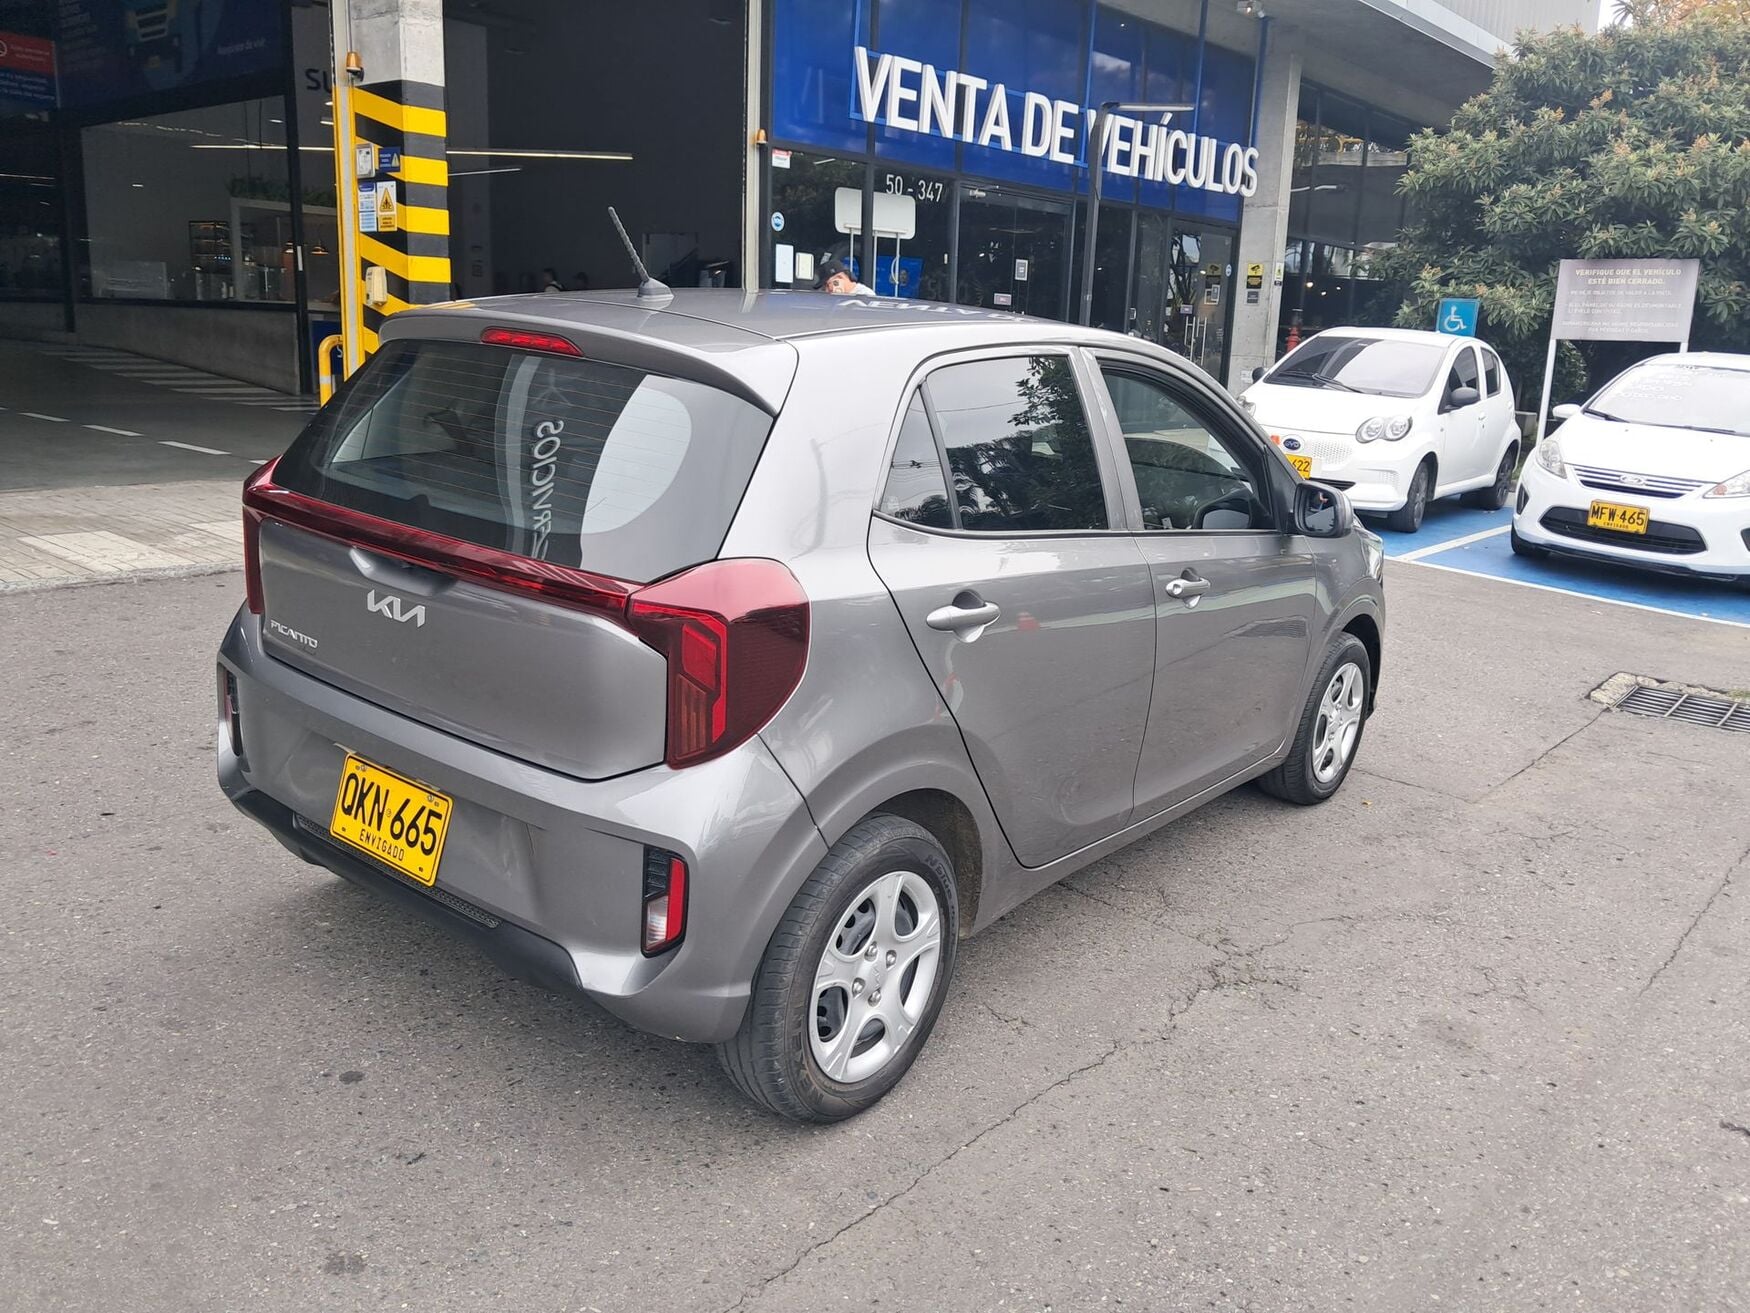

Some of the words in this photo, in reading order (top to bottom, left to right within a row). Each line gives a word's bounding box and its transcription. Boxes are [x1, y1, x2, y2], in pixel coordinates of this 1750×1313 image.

[854, 46, 1012, 151] VENTA
[1021, 91, 1079, 164] DE
[1087, 109, 1260, 197] VEHÍCULOS
[885, 174, 904, 195] 50
[917, 179, 943, 203] 347
[1575, 268, 1614, 276] VERIFIQUE
[1615, 268, 1630, 276] QUE
[1632, 268, 1642, 276] EL
[1644, 266, 1682, 276] VEHÍCULO
[1591, 505, 1616, 522] MFW
[1619, 510, 1646, 527] 465
[367, 589, 426, 628] KIA
[270, 619, 318, 649] PICANTO
[341, 772, 390, 832] QKN
[390, 798, 443, 856] 665
[358, 828, 405, 862] ENVIGADO
